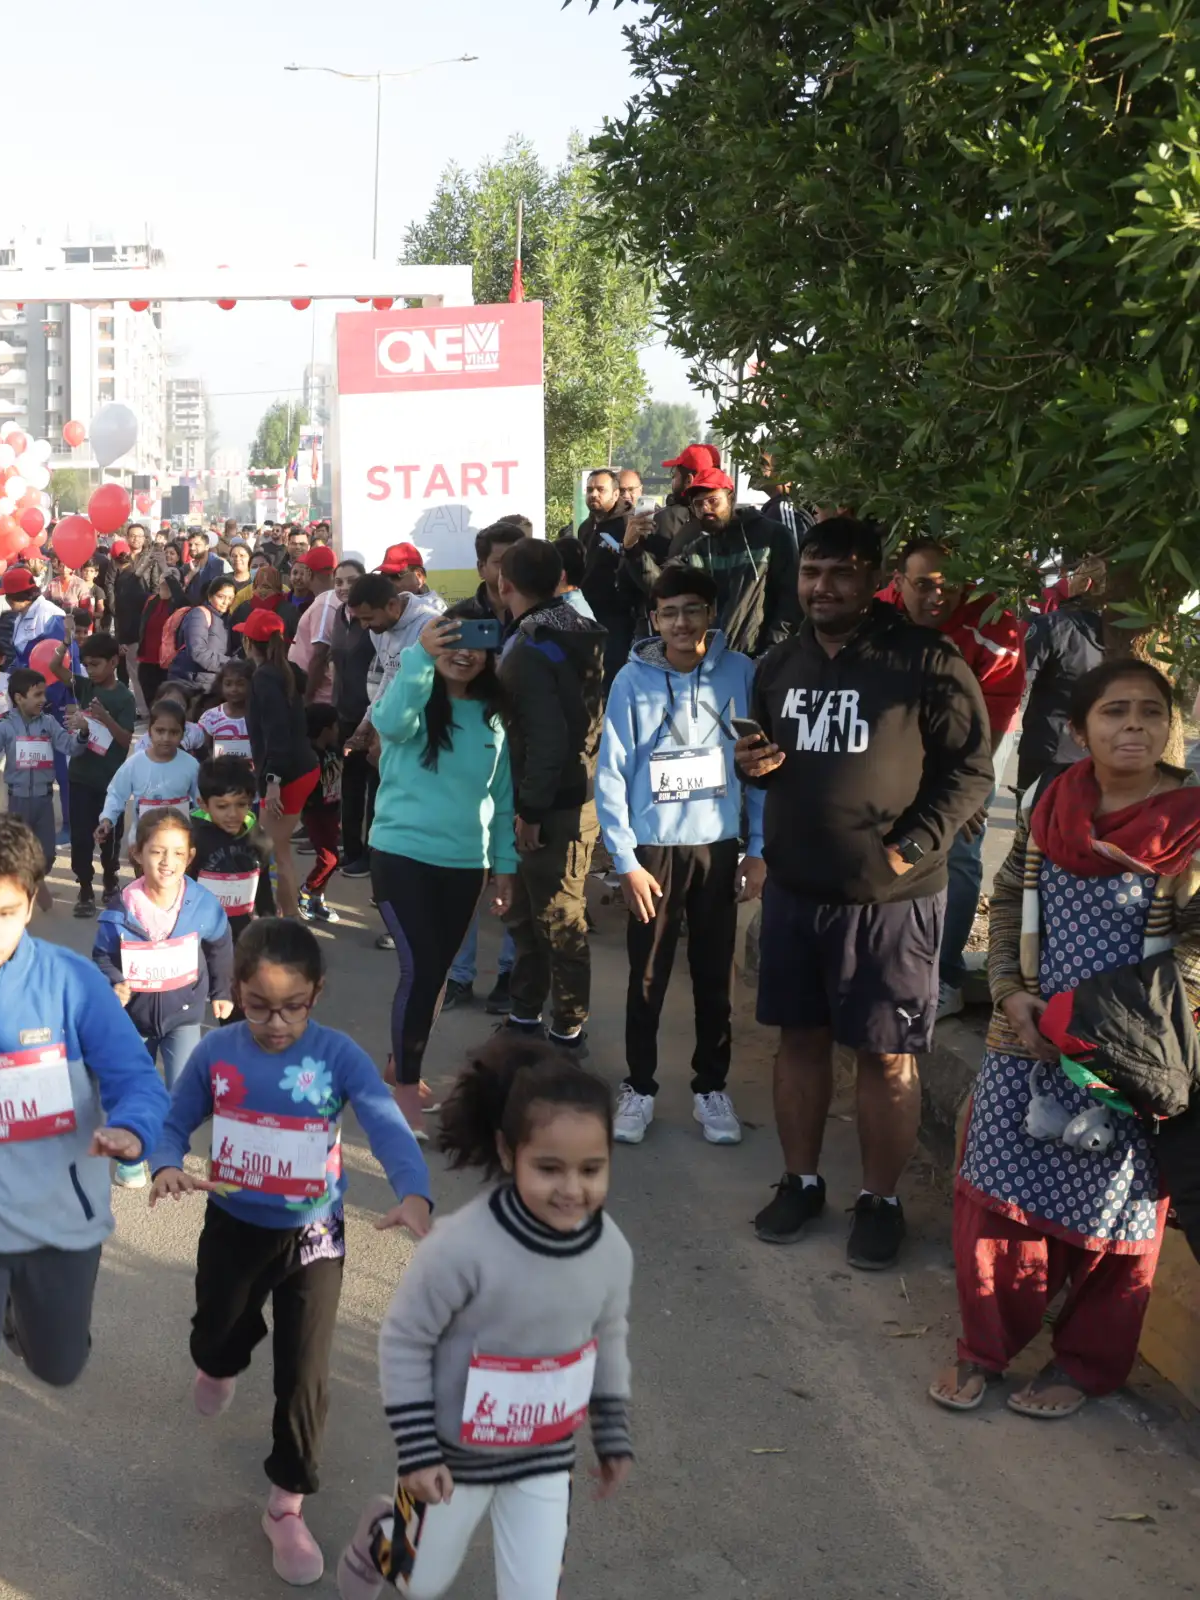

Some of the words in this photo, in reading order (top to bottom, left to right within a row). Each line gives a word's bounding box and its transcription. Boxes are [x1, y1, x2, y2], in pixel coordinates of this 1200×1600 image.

[378, 328, 462, 373] ONE
[367, 461, 519, 501] START
[781, 687, 860, 722] NEVER
[795, 712, 870, 753] MIND
[677, 777, 683, 790] 3
[687, 777, 704, 789] KM
[146, 966, 166, 980] 500
[22, 1099, 38, 1120] M
[218, 1165, 236, 1181] RUN
[243, 1172, 264, 1188] FUN!
[241, 1150, 272, 1173] 500
[278, 1160, 292, 1178] M
[507, 1402, 546, 1424] 500
